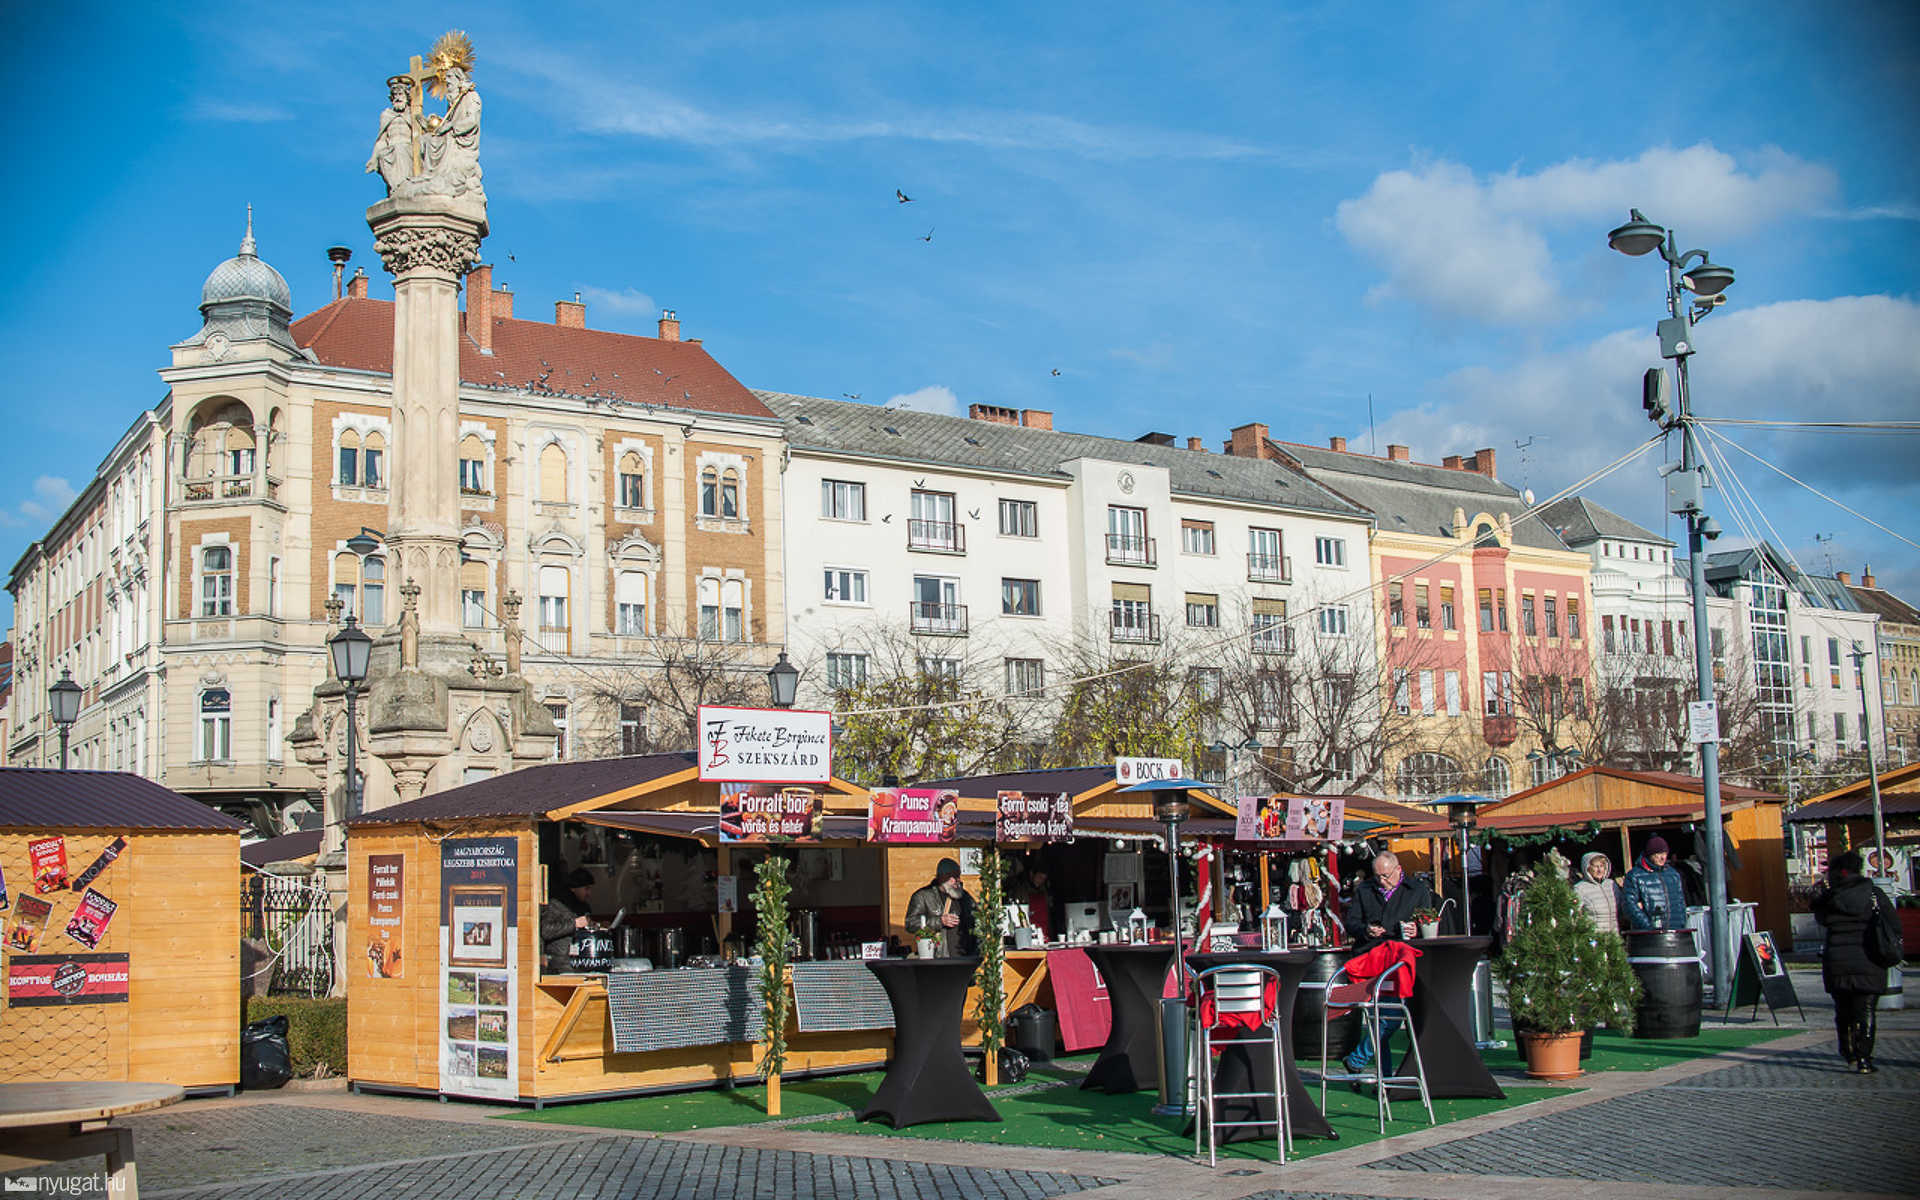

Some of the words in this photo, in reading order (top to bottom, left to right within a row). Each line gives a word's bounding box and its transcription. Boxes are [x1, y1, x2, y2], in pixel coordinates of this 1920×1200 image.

[734, 725, 772, 743] Fekete
[737, 751, 818, 766] SZEKSZÁRD
[1136, 762, 1163, 779] BOCK
[739, 793, 783, 813] Forralt
[786, 793, 808, 813] bor
[900, 794, 929, 811] Puncs
[1002, 796, 1025, 813] Forró
[1027, 797, 1049, 812] csoki
[1057, 798, 1069, 813] tea
[741, 818, 767, 833] vörös
[769, 818, 779, 833] és
[781, 819, 804, 833] fehér
[1004, 819, 1046, 839] Segafredo
[1048, 819, 1067, 836] kávé
[454, 844, 505, 856] MAGYARORSZÁG
